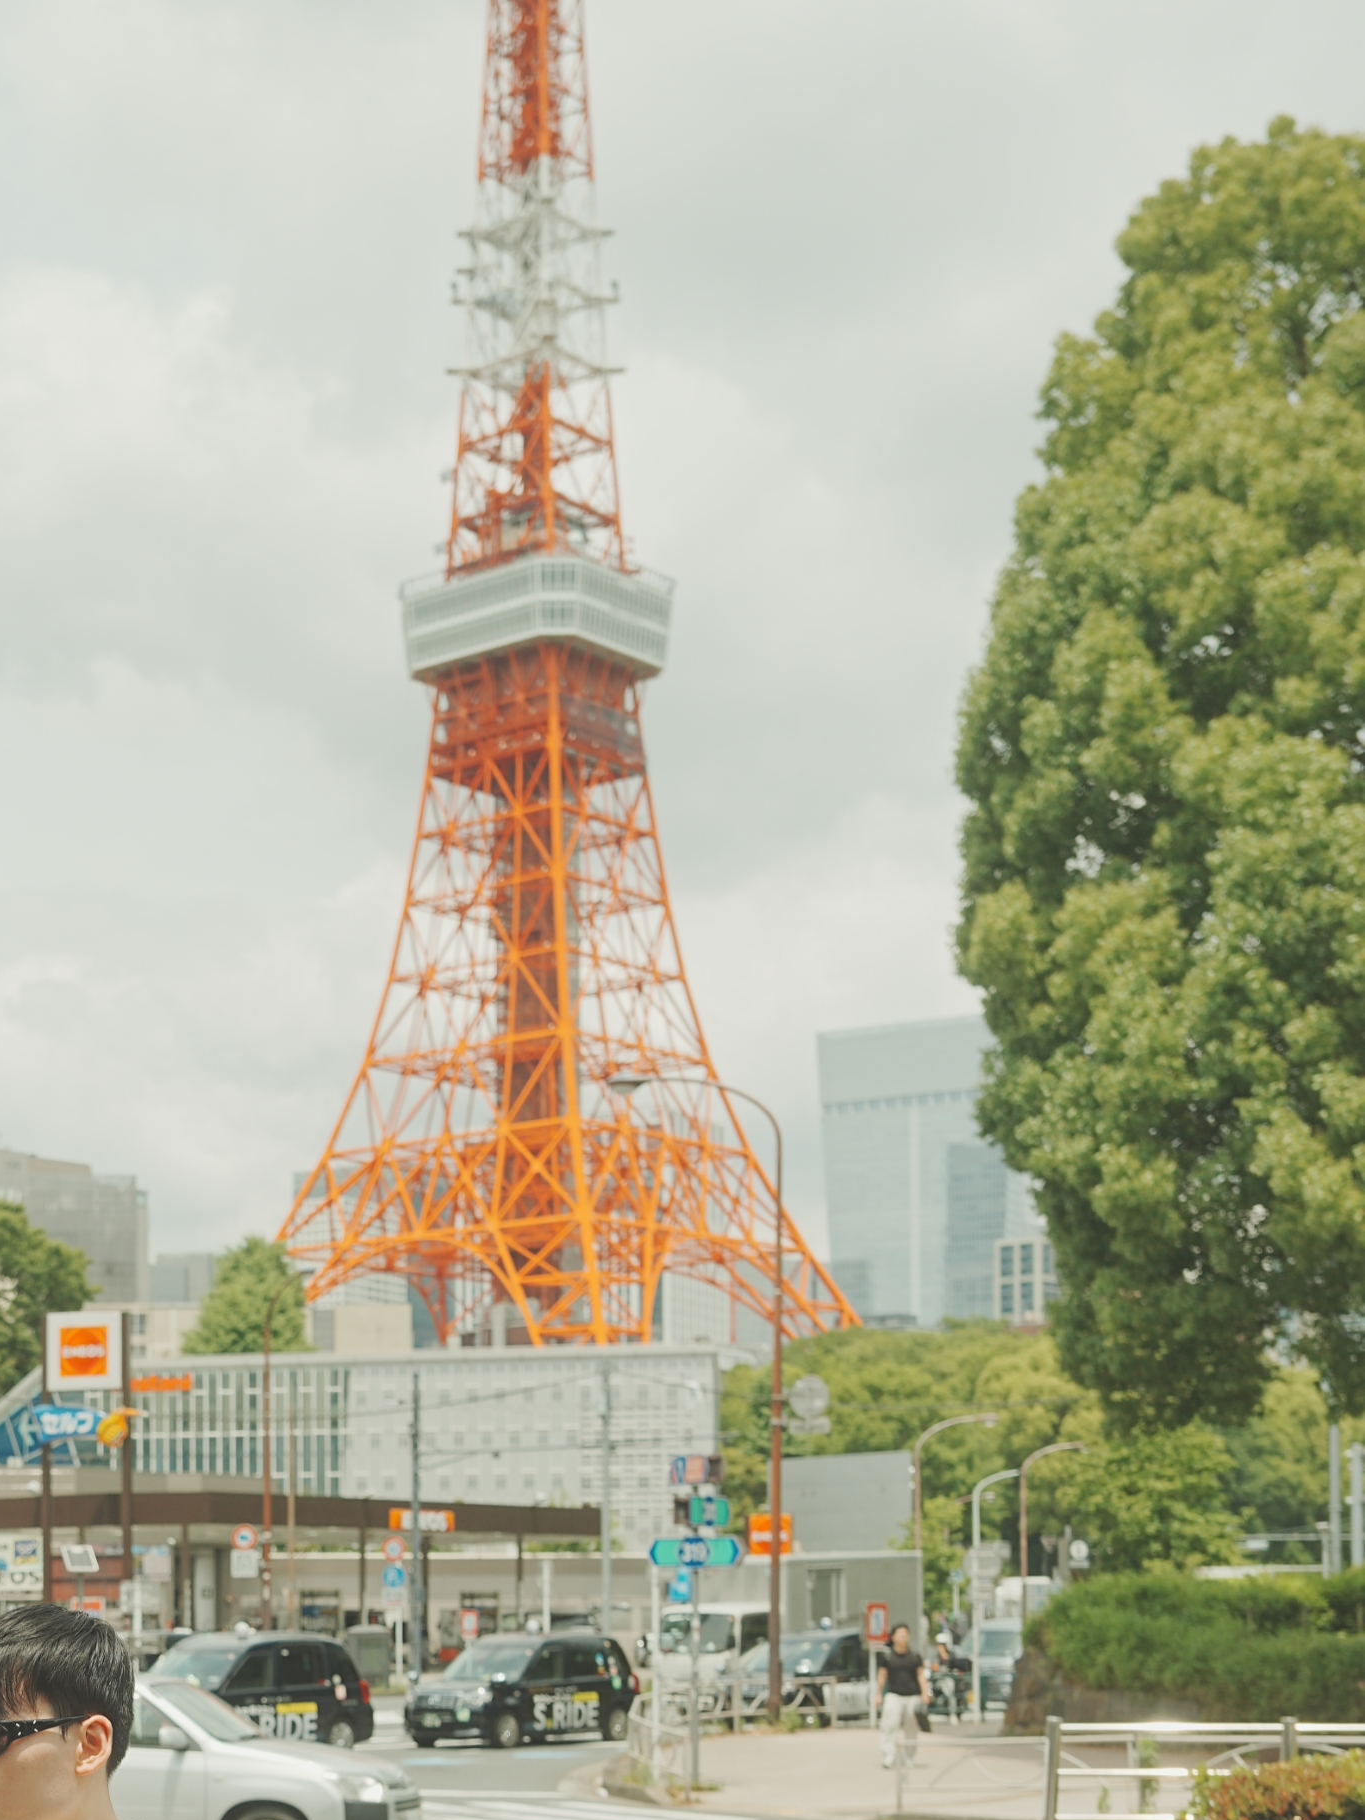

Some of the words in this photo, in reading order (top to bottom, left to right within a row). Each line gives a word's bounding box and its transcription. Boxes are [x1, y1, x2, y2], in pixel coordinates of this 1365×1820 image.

[61, 1344, 106, 1359] ENEOS
[40, 1411, 94, 1435] セルフ
[533, 1701, 600, 1731] S.RIDE
